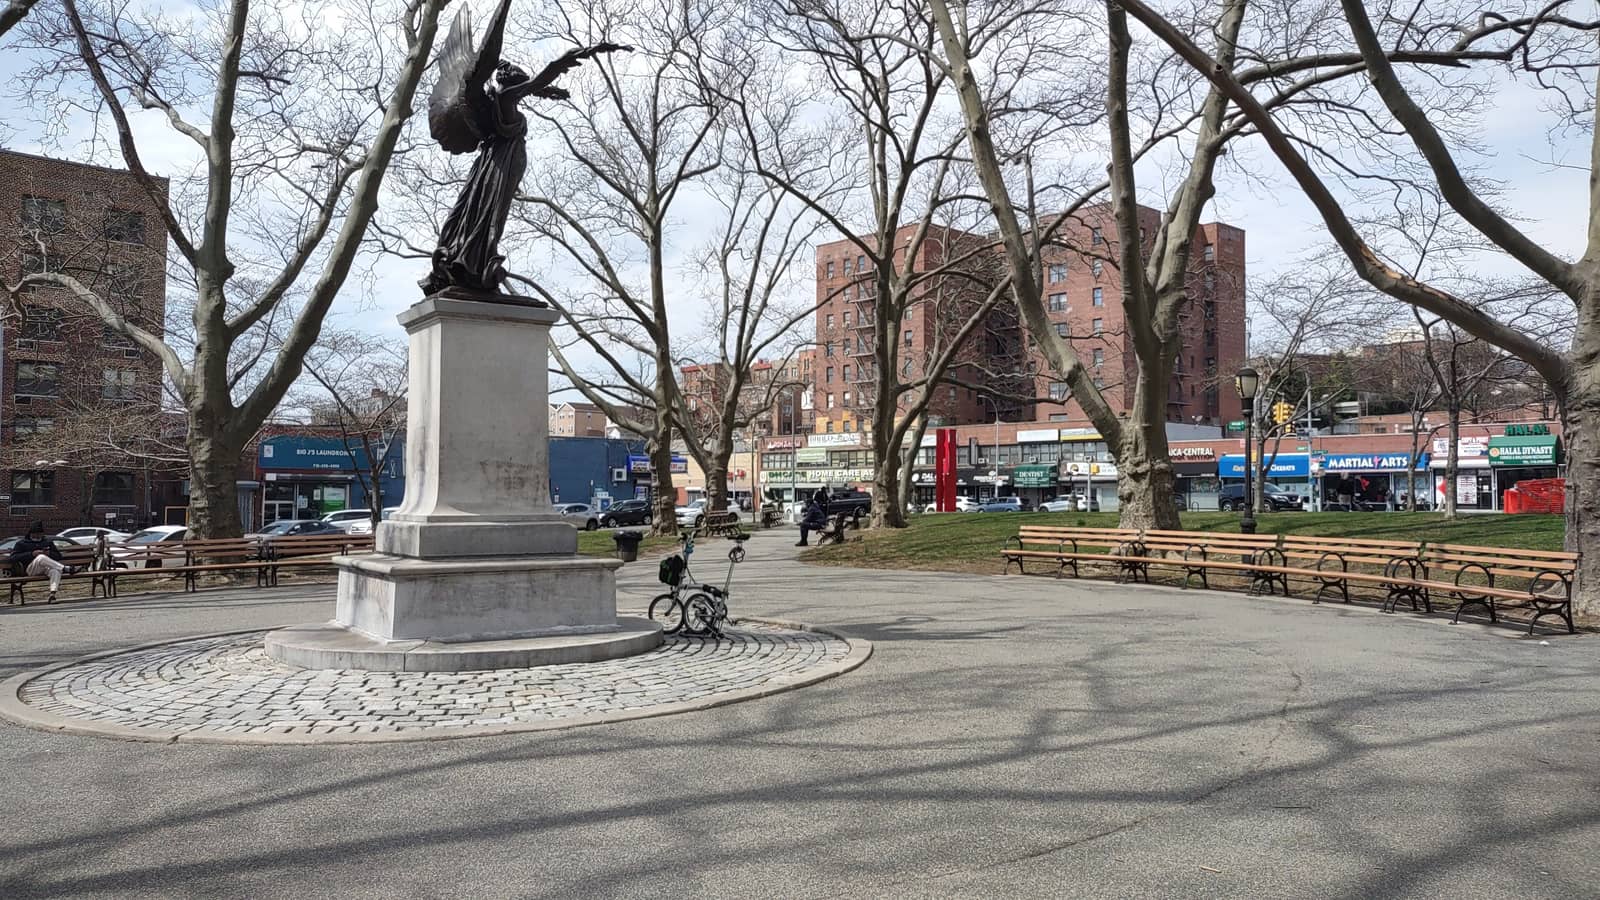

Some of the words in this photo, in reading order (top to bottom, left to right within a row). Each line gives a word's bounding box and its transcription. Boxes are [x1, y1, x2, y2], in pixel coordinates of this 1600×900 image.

[1505, 424, 1550, 435] HALAL
[1169, 448, 1213, 456] ICA-CENTRAL
[1523, 446, 1553, 454] DYNASTY
[1329, 459, 1373, 468] MARTIAL
[1381, 457, 1408, 467] ARTS
[837, 469, 860, 477] CARE
